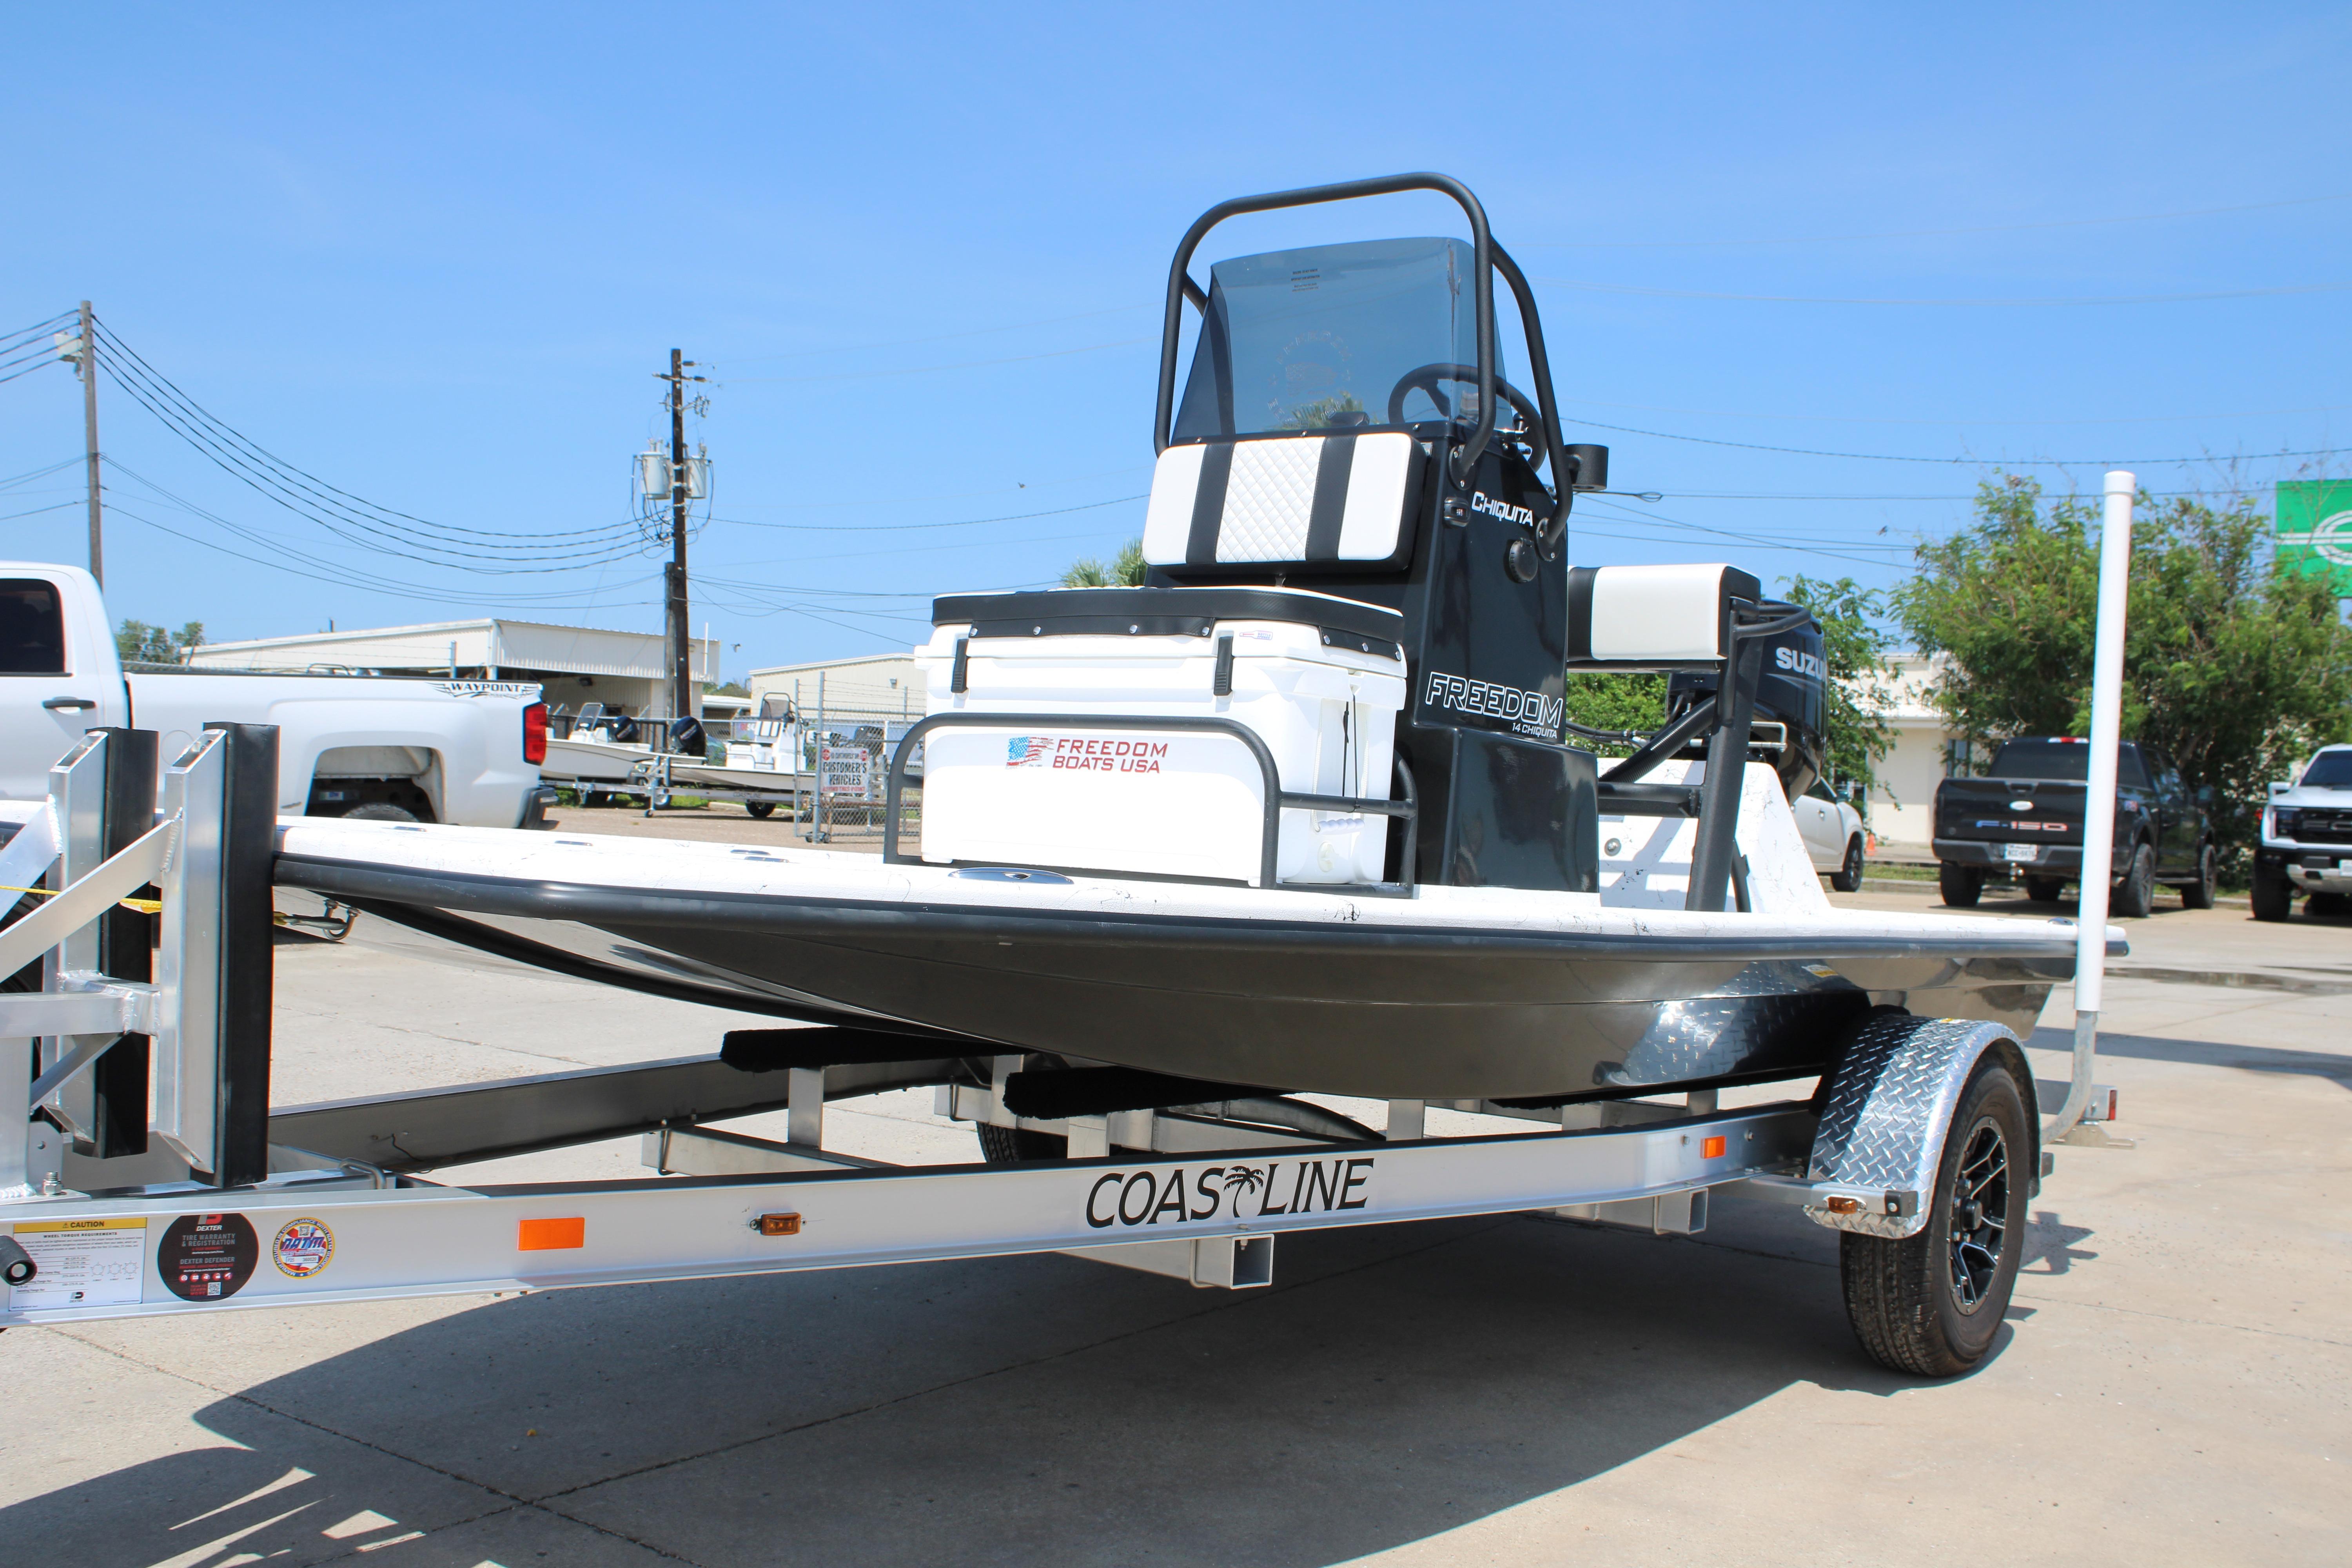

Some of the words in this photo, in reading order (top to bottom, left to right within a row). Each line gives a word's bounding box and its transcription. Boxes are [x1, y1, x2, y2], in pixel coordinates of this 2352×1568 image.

[1472, 491, 1533, 526] CHIQUITA
[451, 683, 521, 692] WAYPOINT
[1425, 671, 1563, 729] FREEDOM
[1512, 722, 1521, 732] 14
[1522, 724, 1557, 739] CHIQUITA
[1057, 739, 1168, 757] FREEDOM
[823, 762, 866, 773] CUSTOMER'S
[1053, 755, 1114, 771] BOATS
[1120, 759, 1160, 773] USA
[829, 774, 861, 786] VEHICLES
[1976, 820, 2068, 831] F-150
[282, 1219, 317, 1233] COMPLIANCE
[316, 1221, 328, 1234] WITH
